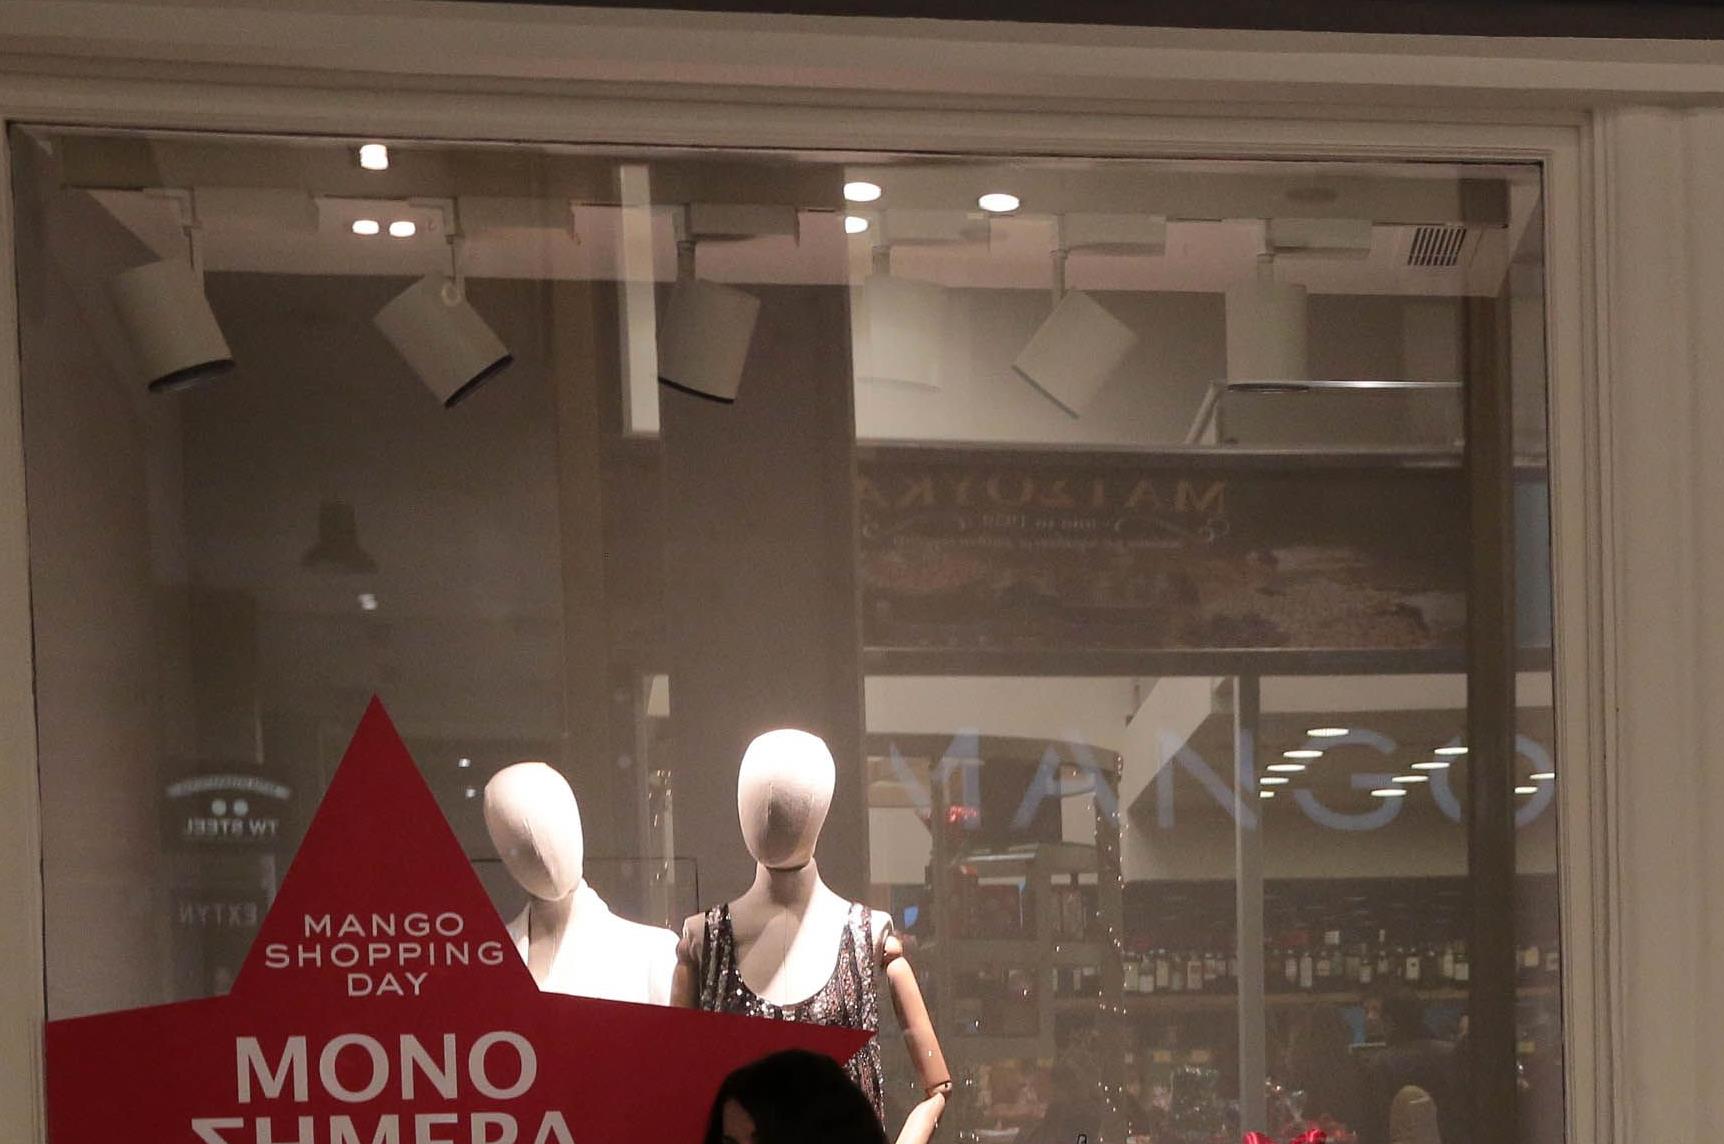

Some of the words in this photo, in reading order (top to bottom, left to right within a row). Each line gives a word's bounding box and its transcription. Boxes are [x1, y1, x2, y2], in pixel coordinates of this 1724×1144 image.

[890, 727, 1553, 832] MANGO
[304, 912, 464, 938] MANGO
[265, 941, 504, 969] SHOPPING
[347, 972, 428, 997] DAY
[236, 1031, 537, 1104] ΜΟΝΟ
